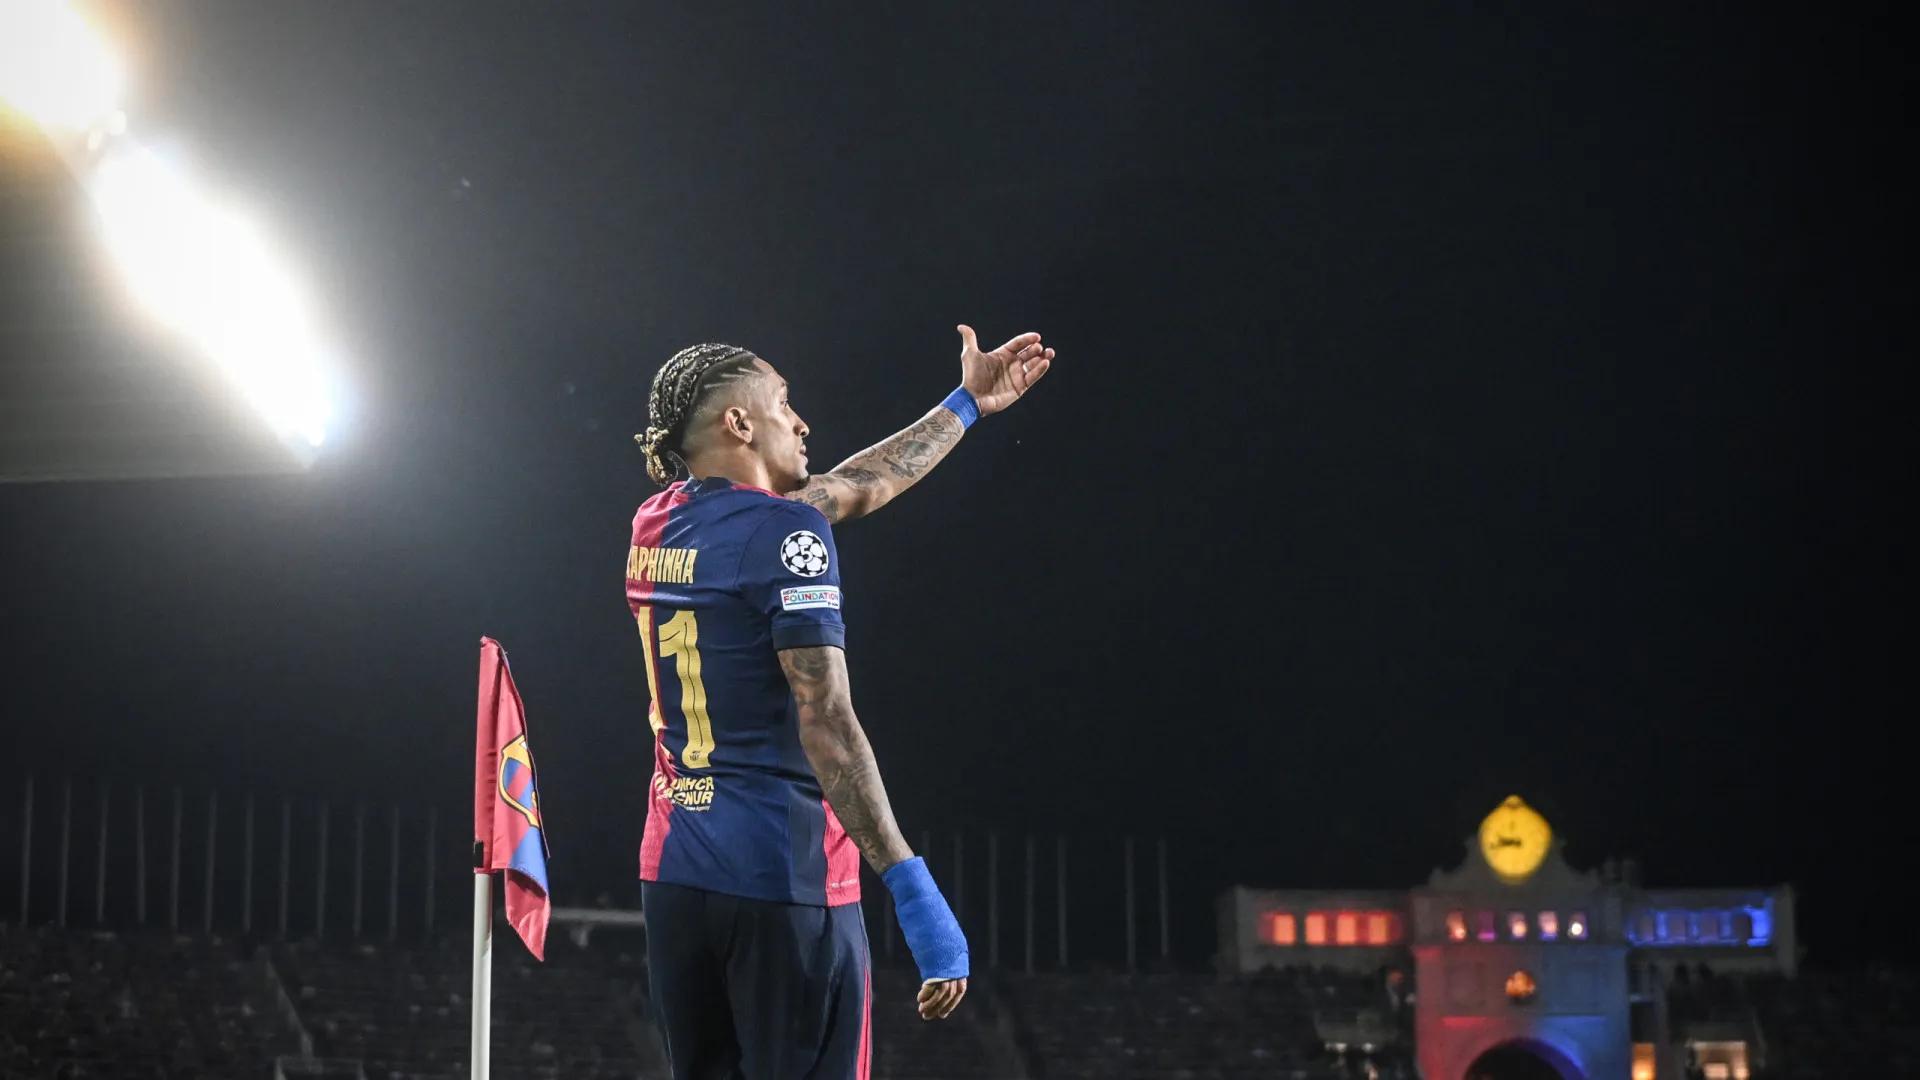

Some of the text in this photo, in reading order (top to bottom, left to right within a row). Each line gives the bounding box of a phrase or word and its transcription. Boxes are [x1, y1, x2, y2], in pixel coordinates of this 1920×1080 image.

[626, 545, 697, 584] APHINHA
[783, 592, 839, 603] FOUNDATION
[671, 776, 714, 791] UNHCR
